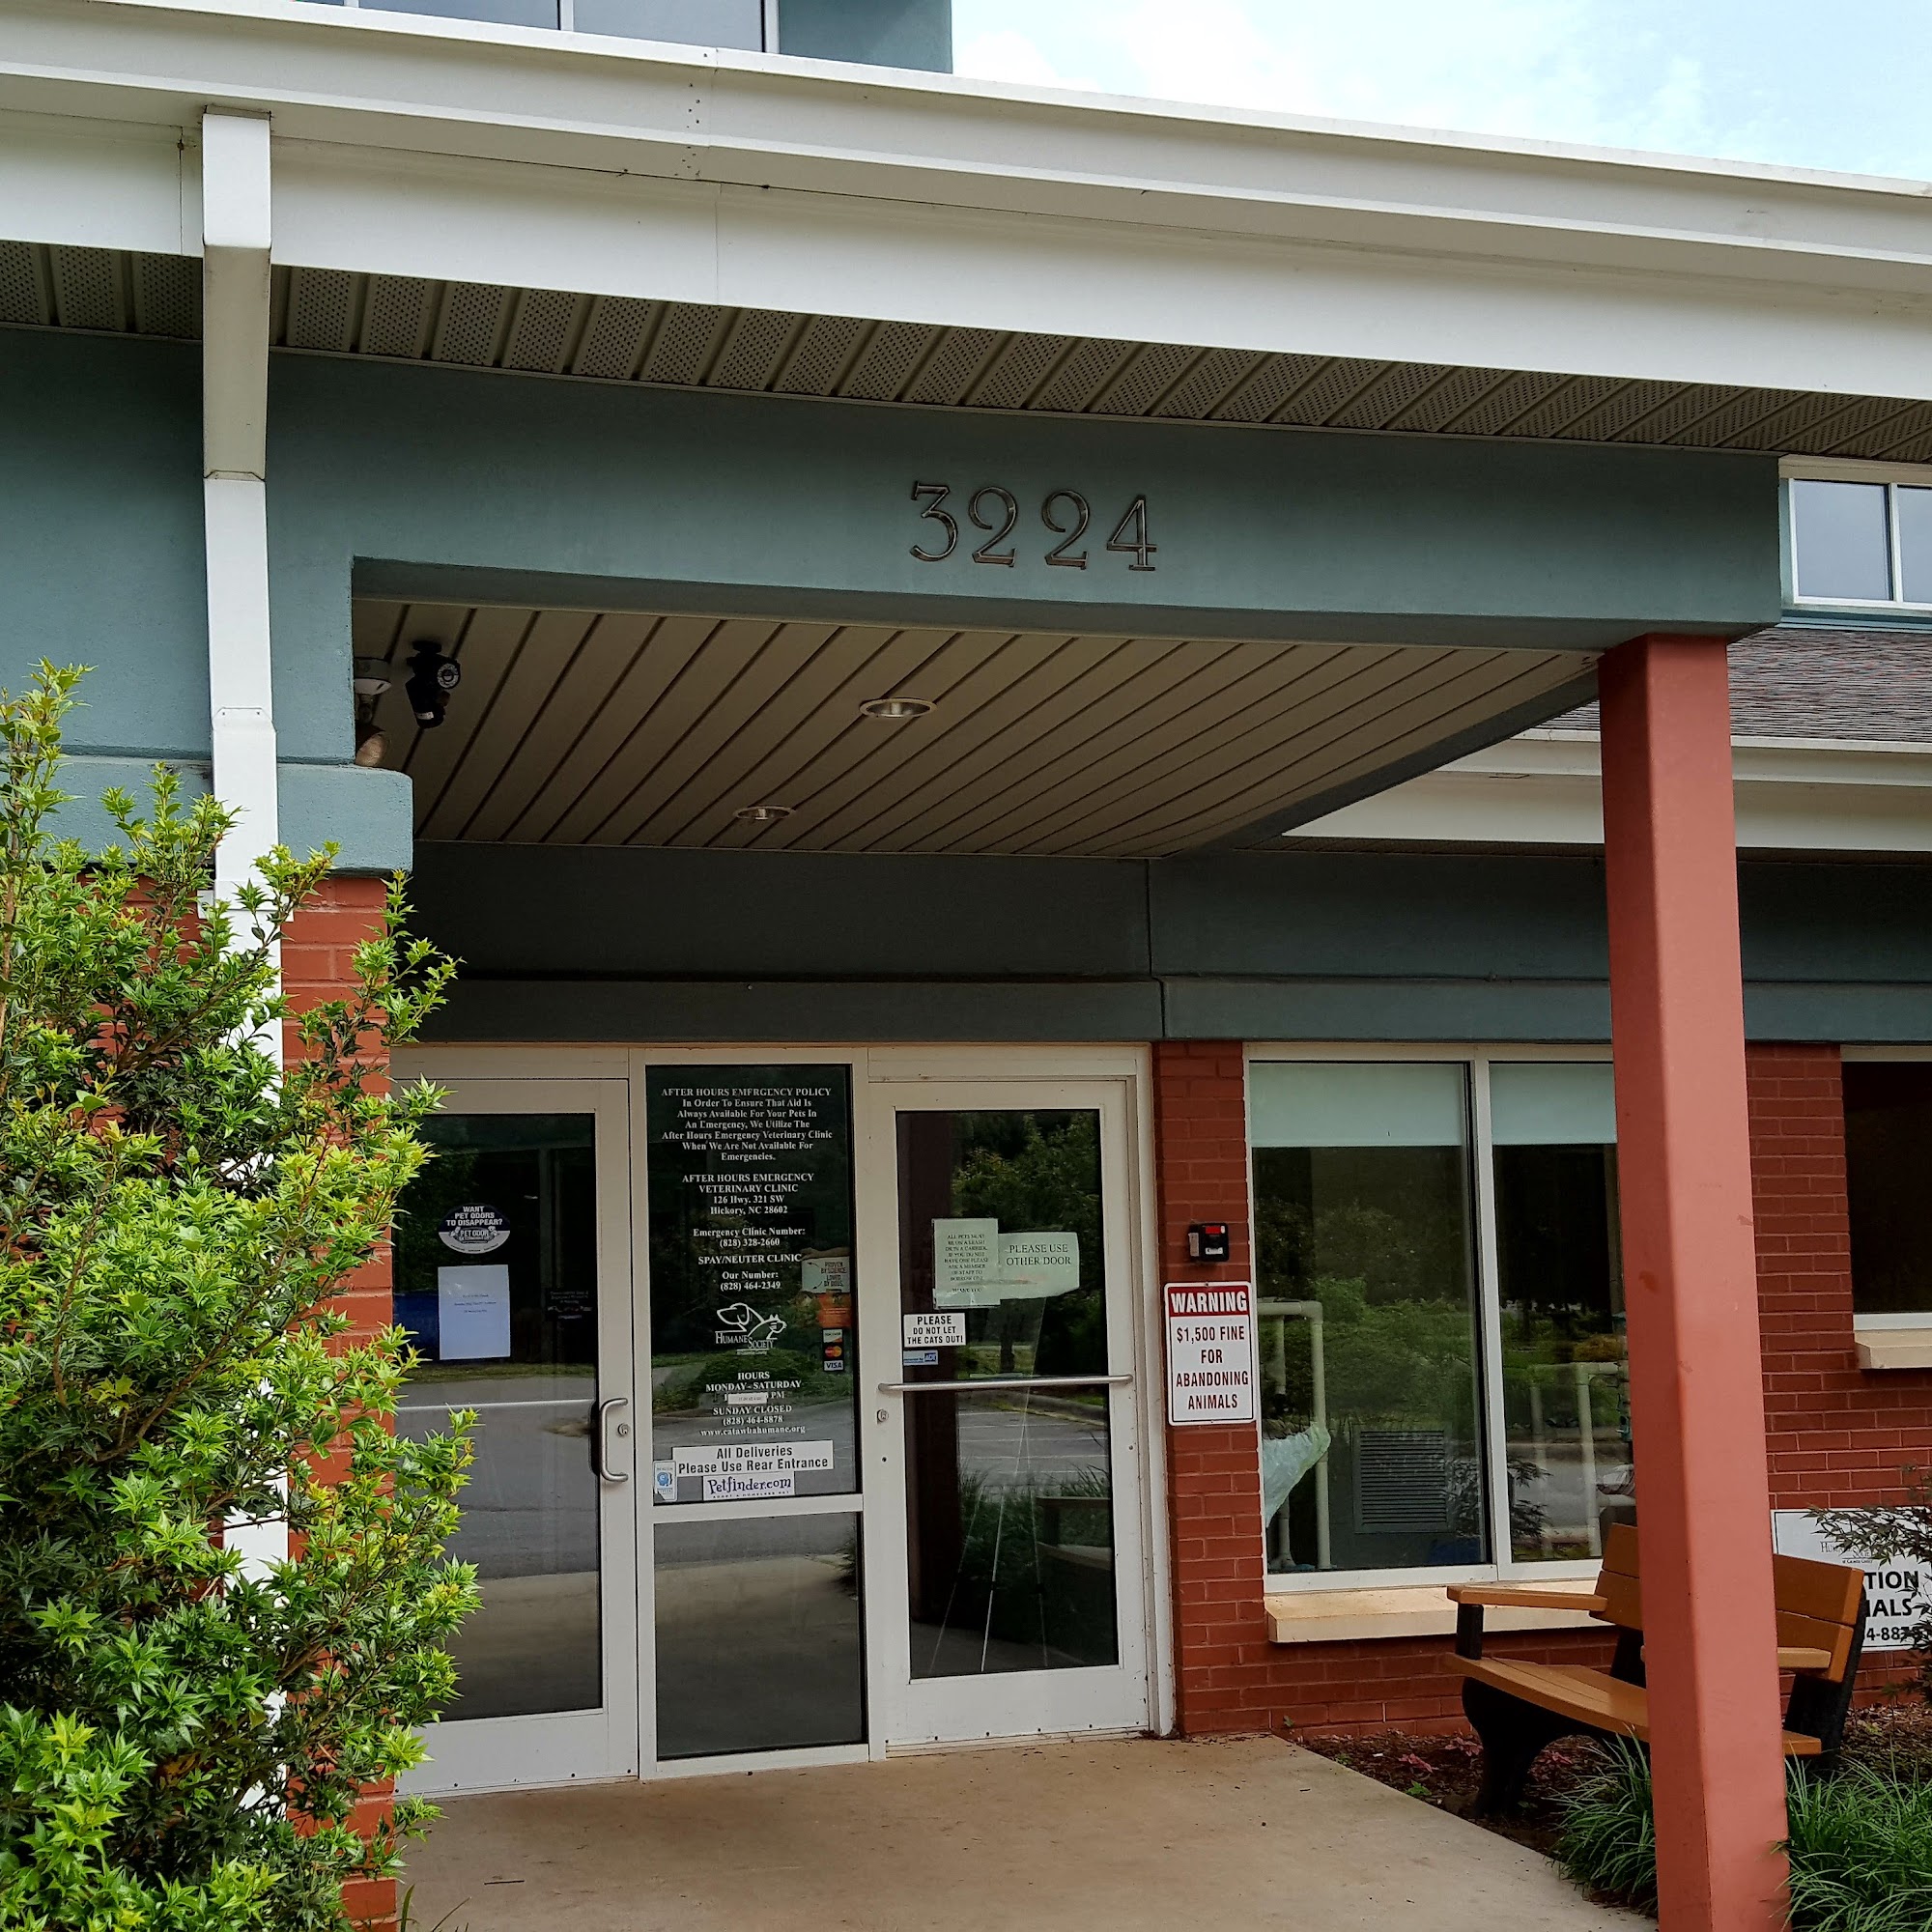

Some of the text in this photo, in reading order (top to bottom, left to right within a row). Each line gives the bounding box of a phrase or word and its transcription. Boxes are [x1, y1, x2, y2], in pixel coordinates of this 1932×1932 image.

[910, 480, 1157, 572] 3224
[677, 1111, 707, 1120] Always
[699, 1121, 748, 1130] Emergency,
[715, 1132, 760, 1141] Emergency
[682, 1142, 707, 1151] When
[721, 1153, 776, 1162] Emergencies.
[718, 1174, 751, 1182] HOURS
[699, 1184, 762, 1193] VETERINARY
[730, 1196, 751, 1205] Hwy.
[710, 1207, 746, 1215] Hickory,
[764, 1206, 788, 1214] 28602
[693, 1229, 740, 1237] Emergency
[769, 1227, 806, 1236] Number:
[720, 1238, 741, 1248] (828)
[1009, 1244, 1069, 1254] PLEASE USE
[697, 1254, 802, 1264] SPAY/NEUTER CLINIC
[1006, 1256, 1071, 1265] OTHER DOOR
[721, 1281, 781, 1291] (828) 464-2349
[1171, 1291, 1247, 1314] WARNING
[918, 1316, 952, 1324] PLEASE
[1177, 1325, 1244, 1344] $1,500 FINE
[1201, 1350, 1222, 1364] FOR
[737, 1372, 770, 1380] HOURS
[1177, 1371, 1249, 1387] ABANDONING
[706, 1382, 747, 1392] MONDAY
[753, 1380, 802, 1389] SATURDAY
[1188, 1394, 1237, 1410] ANIMALS
[713, 1405, 792, 1415] SUNDAY CLOSED
[723, 1417, 744, 1426] (828)
[699, 1425, 806, 1435] www.catawbahumane.org
[717, 1446, 792, 1460] All Deliveries
[678, 1459, 828, 1474] Please Use Rear Entrance
[707, 1476, 791, 1494] Petfinder.com
[1864, 1571, 1918, 1589] TION
[1866, 1598, 1913, 1617] ALS
